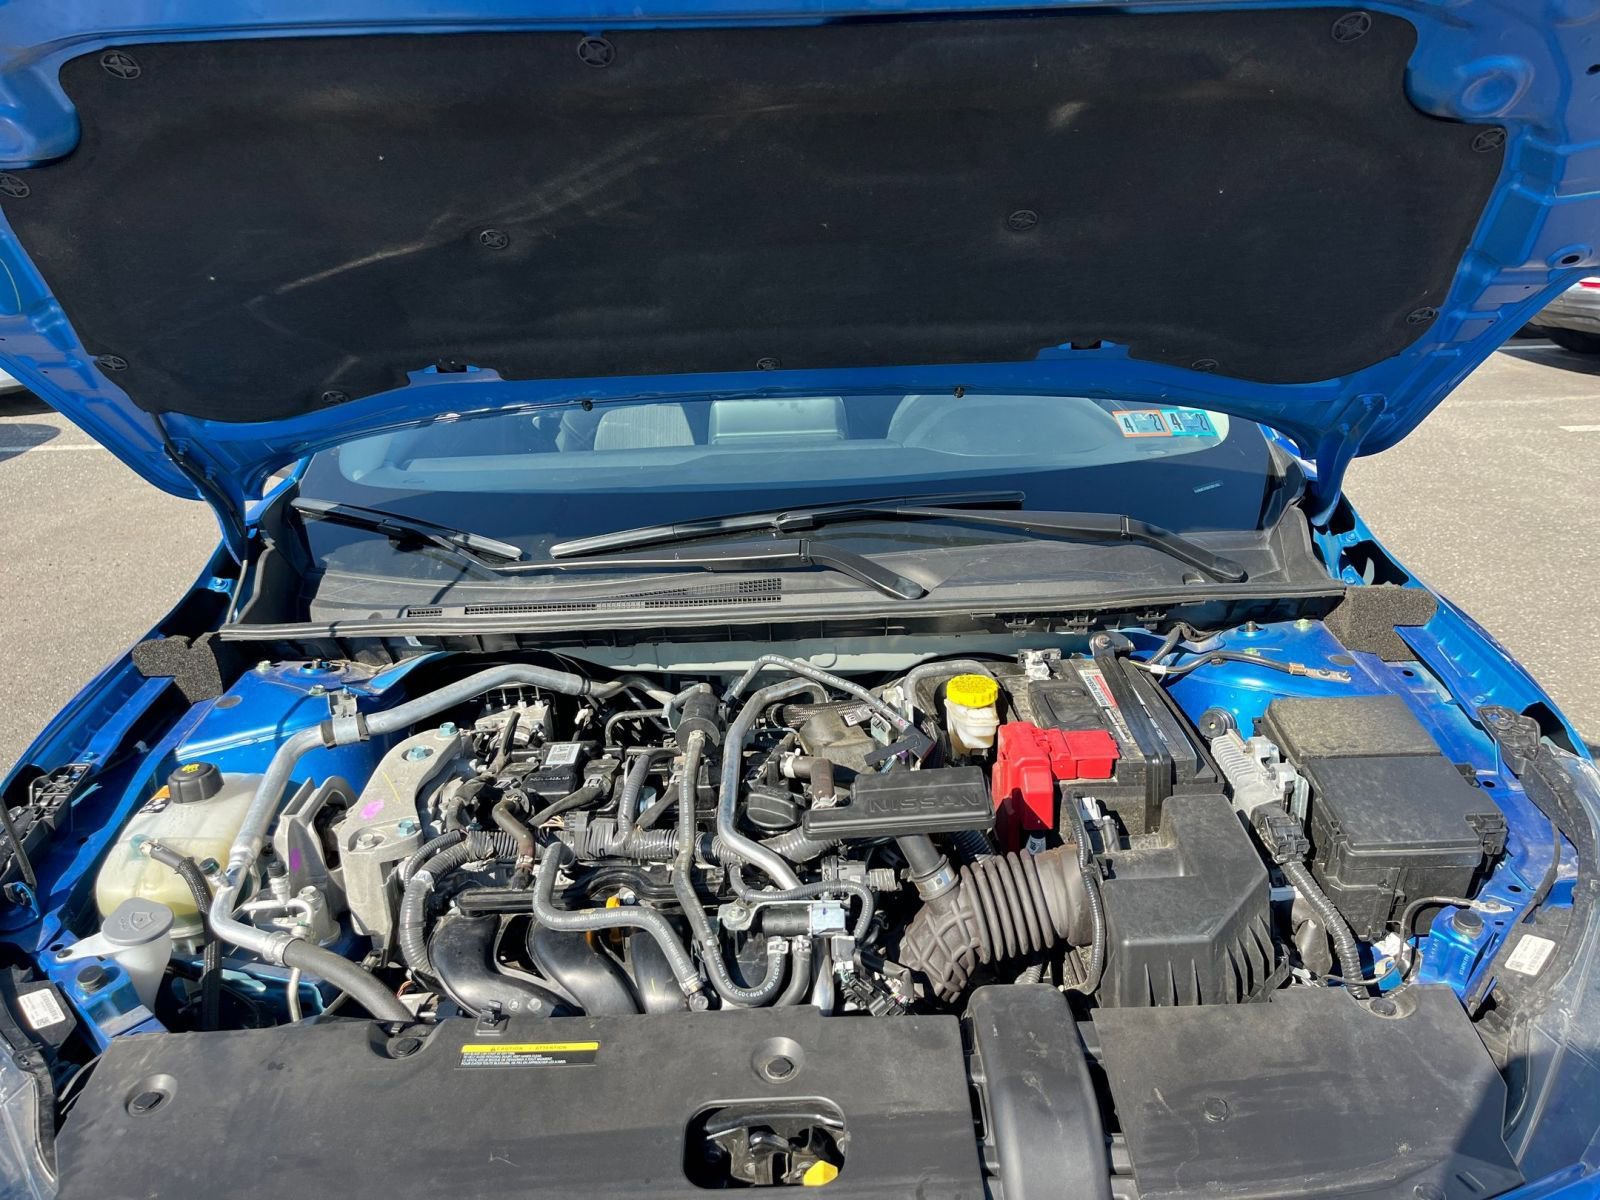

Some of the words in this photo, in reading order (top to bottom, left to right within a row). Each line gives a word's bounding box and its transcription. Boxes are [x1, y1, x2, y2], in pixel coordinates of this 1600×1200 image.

[1123, 417, 1135, 433] 4
[1169, 412, 1183, 431] 4
[868, 793, 981, 813] NISSAN
